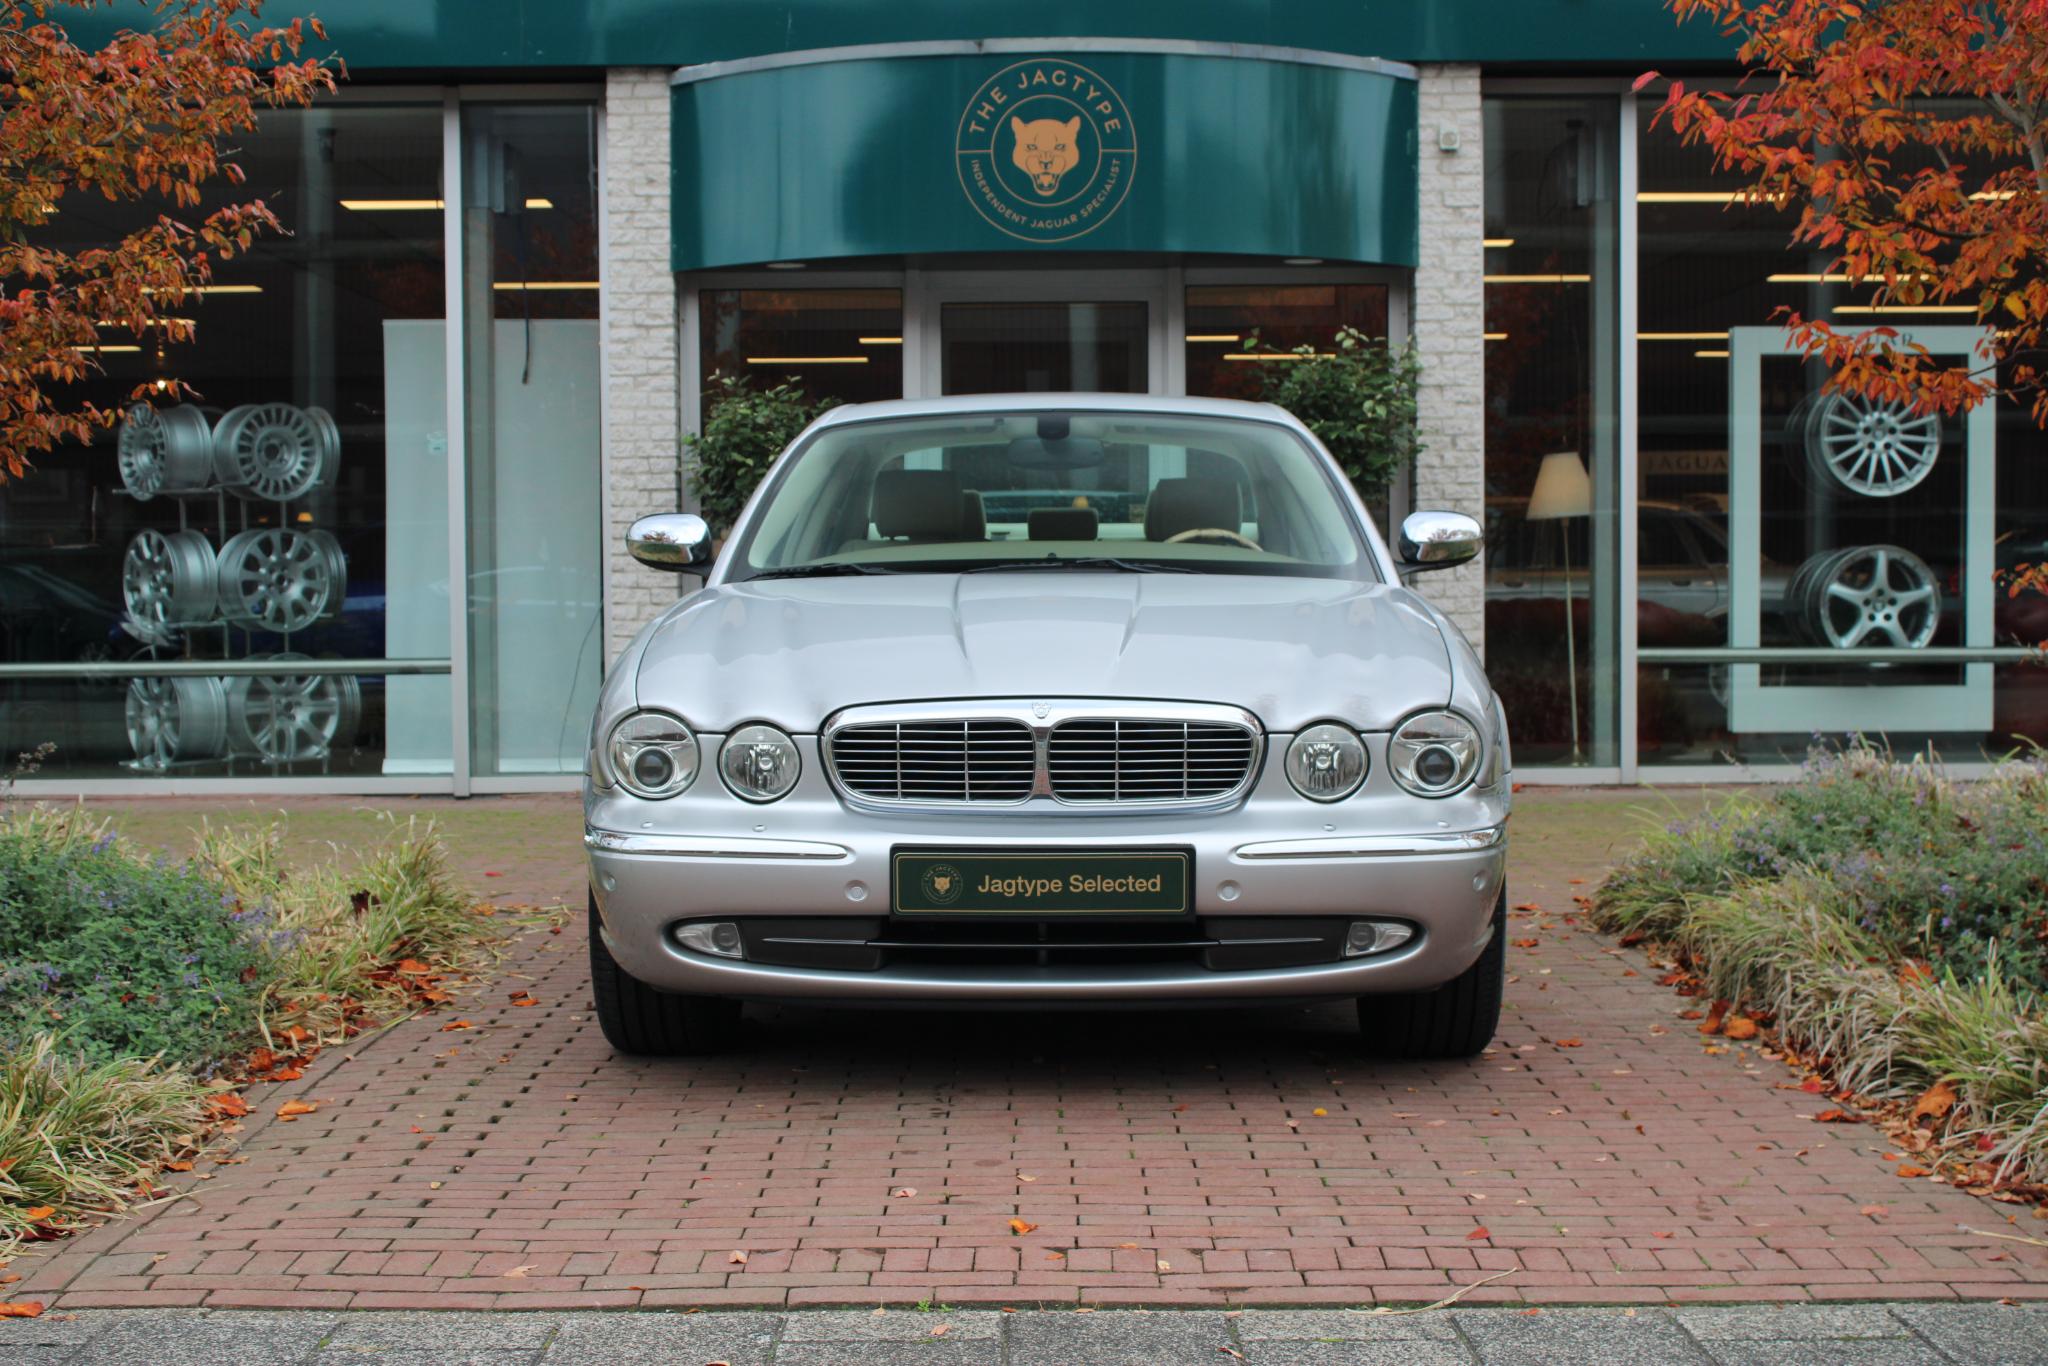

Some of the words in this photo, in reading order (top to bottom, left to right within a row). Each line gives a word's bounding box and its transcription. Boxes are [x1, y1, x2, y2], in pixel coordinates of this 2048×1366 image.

[969, 86, 1007, 133] THE
[1018, 69, 1121, 133] JAGTYPE
[971, 159, 1027, 224] INDEPENDENT
[1030, 214, 1078, 229] JAGUAR
[1080, 159, 1121, 217] SPECIALIST
[1648, 455, 1729, 471] JAGUA
[978, 874, 1063, 897] Jagtype
[1069, 874, 1161, 893] Selected
